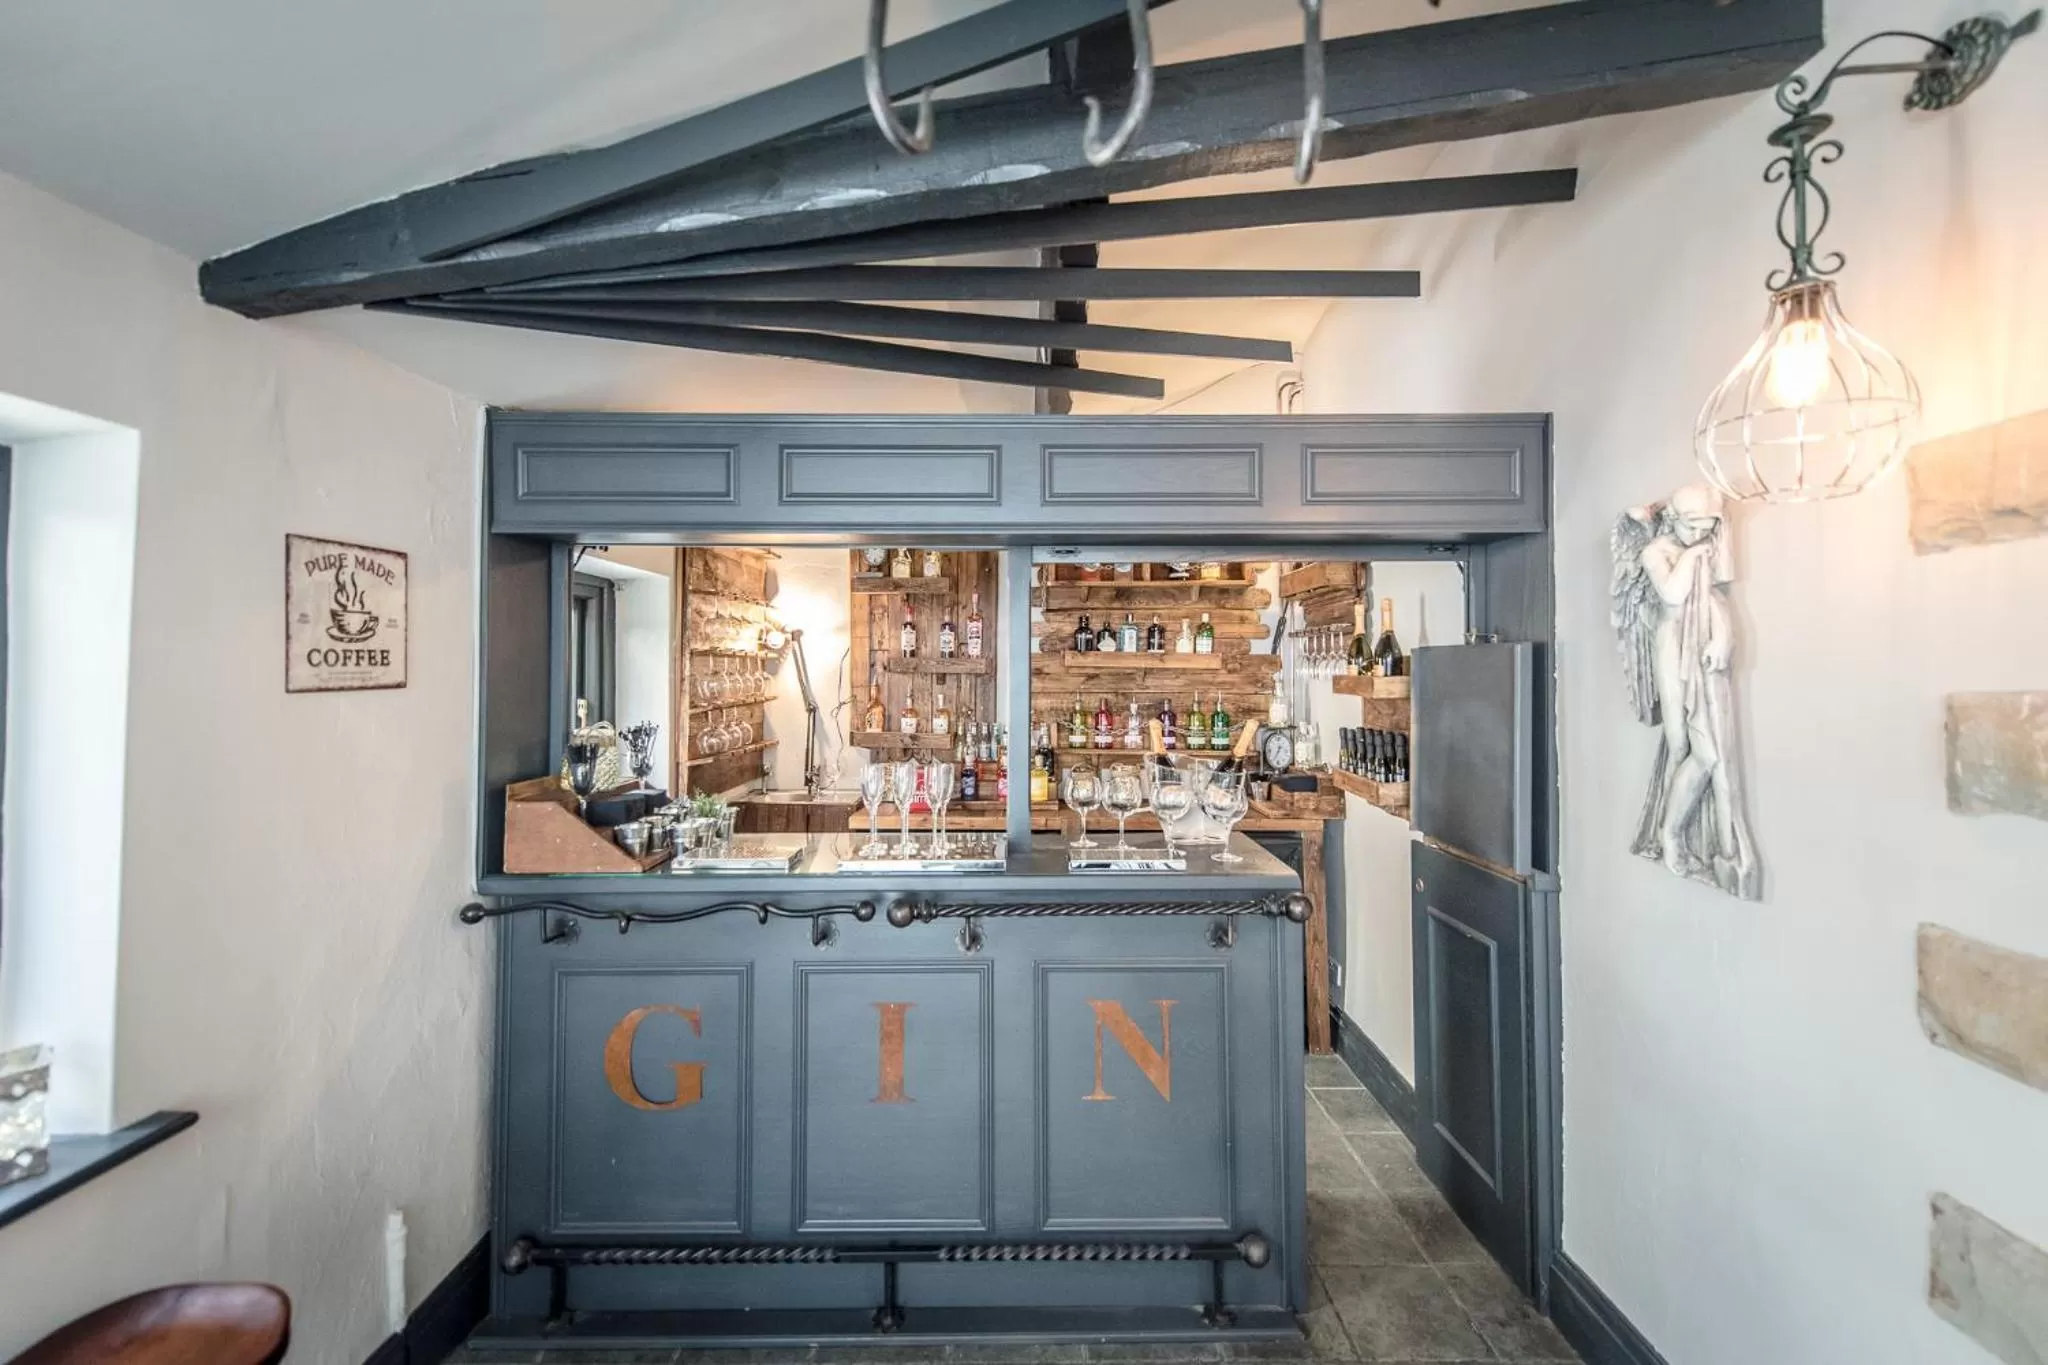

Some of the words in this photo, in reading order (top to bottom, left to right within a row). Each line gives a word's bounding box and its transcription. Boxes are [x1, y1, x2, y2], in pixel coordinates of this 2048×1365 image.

[304, 553, 348, 576] PURE
[354, 555, 395, 585] MADE
[307, 648, 390, 667] COFFEE
